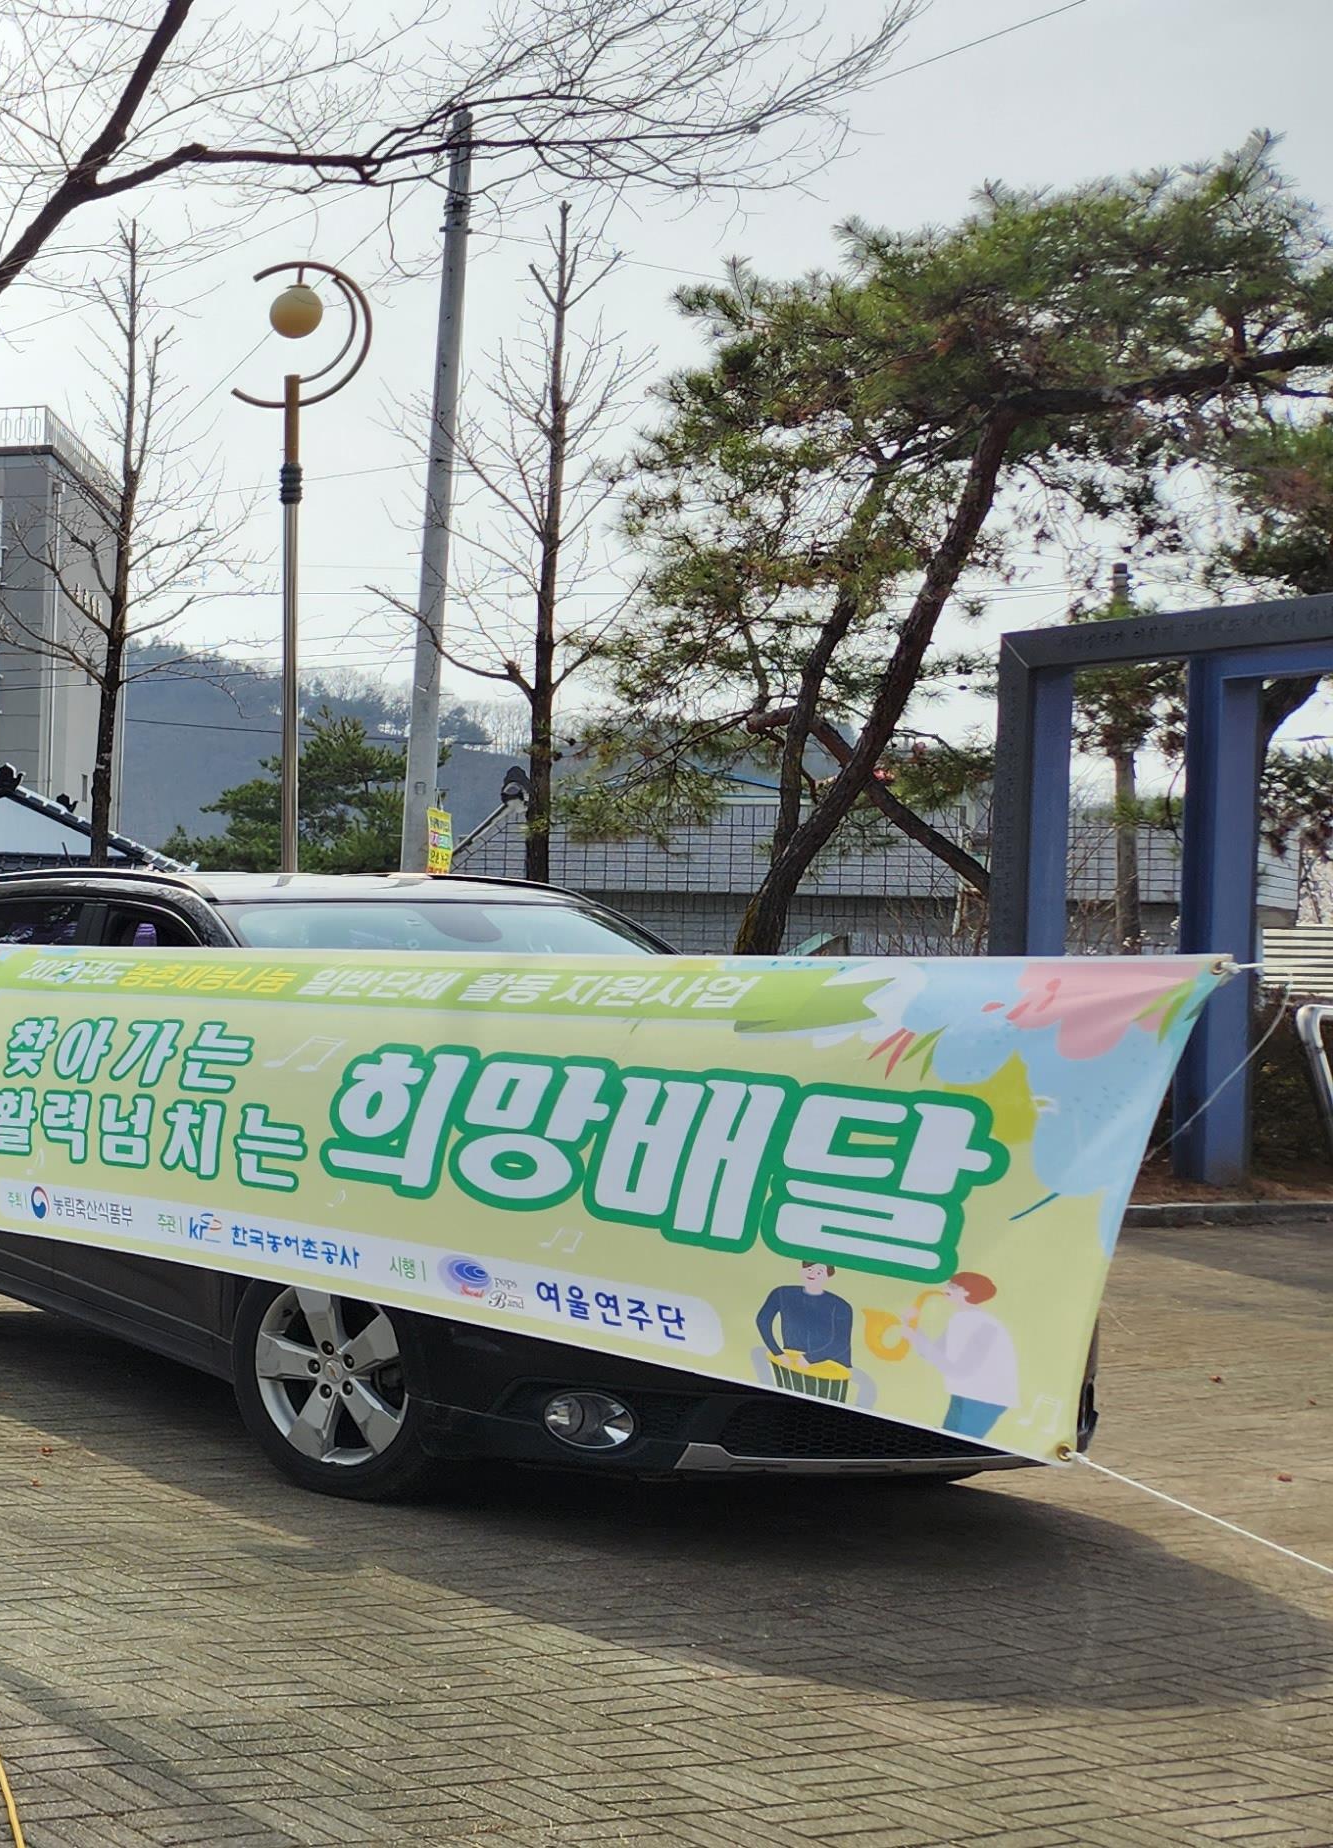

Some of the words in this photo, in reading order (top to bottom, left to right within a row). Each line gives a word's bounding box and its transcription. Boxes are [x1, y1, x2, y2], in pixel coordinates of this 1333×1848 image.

[296, 968, 464, 1000] 일반단체
[458, 973, 565, 1005] 활동
[549, 974, 761, 1008] 지원사업
[3, 1016, 255, 1093] 찾아가는
[320, 1043, 1010, 1284] 희망배달
[53, 1194, 134, 1228] 농림축산식품부
[231, 1225, 361, 1269] 한국농어촌공사
[389, 1255, 416, 1281] 시행
[536, 1280, 687, 1341] 여울연주단
